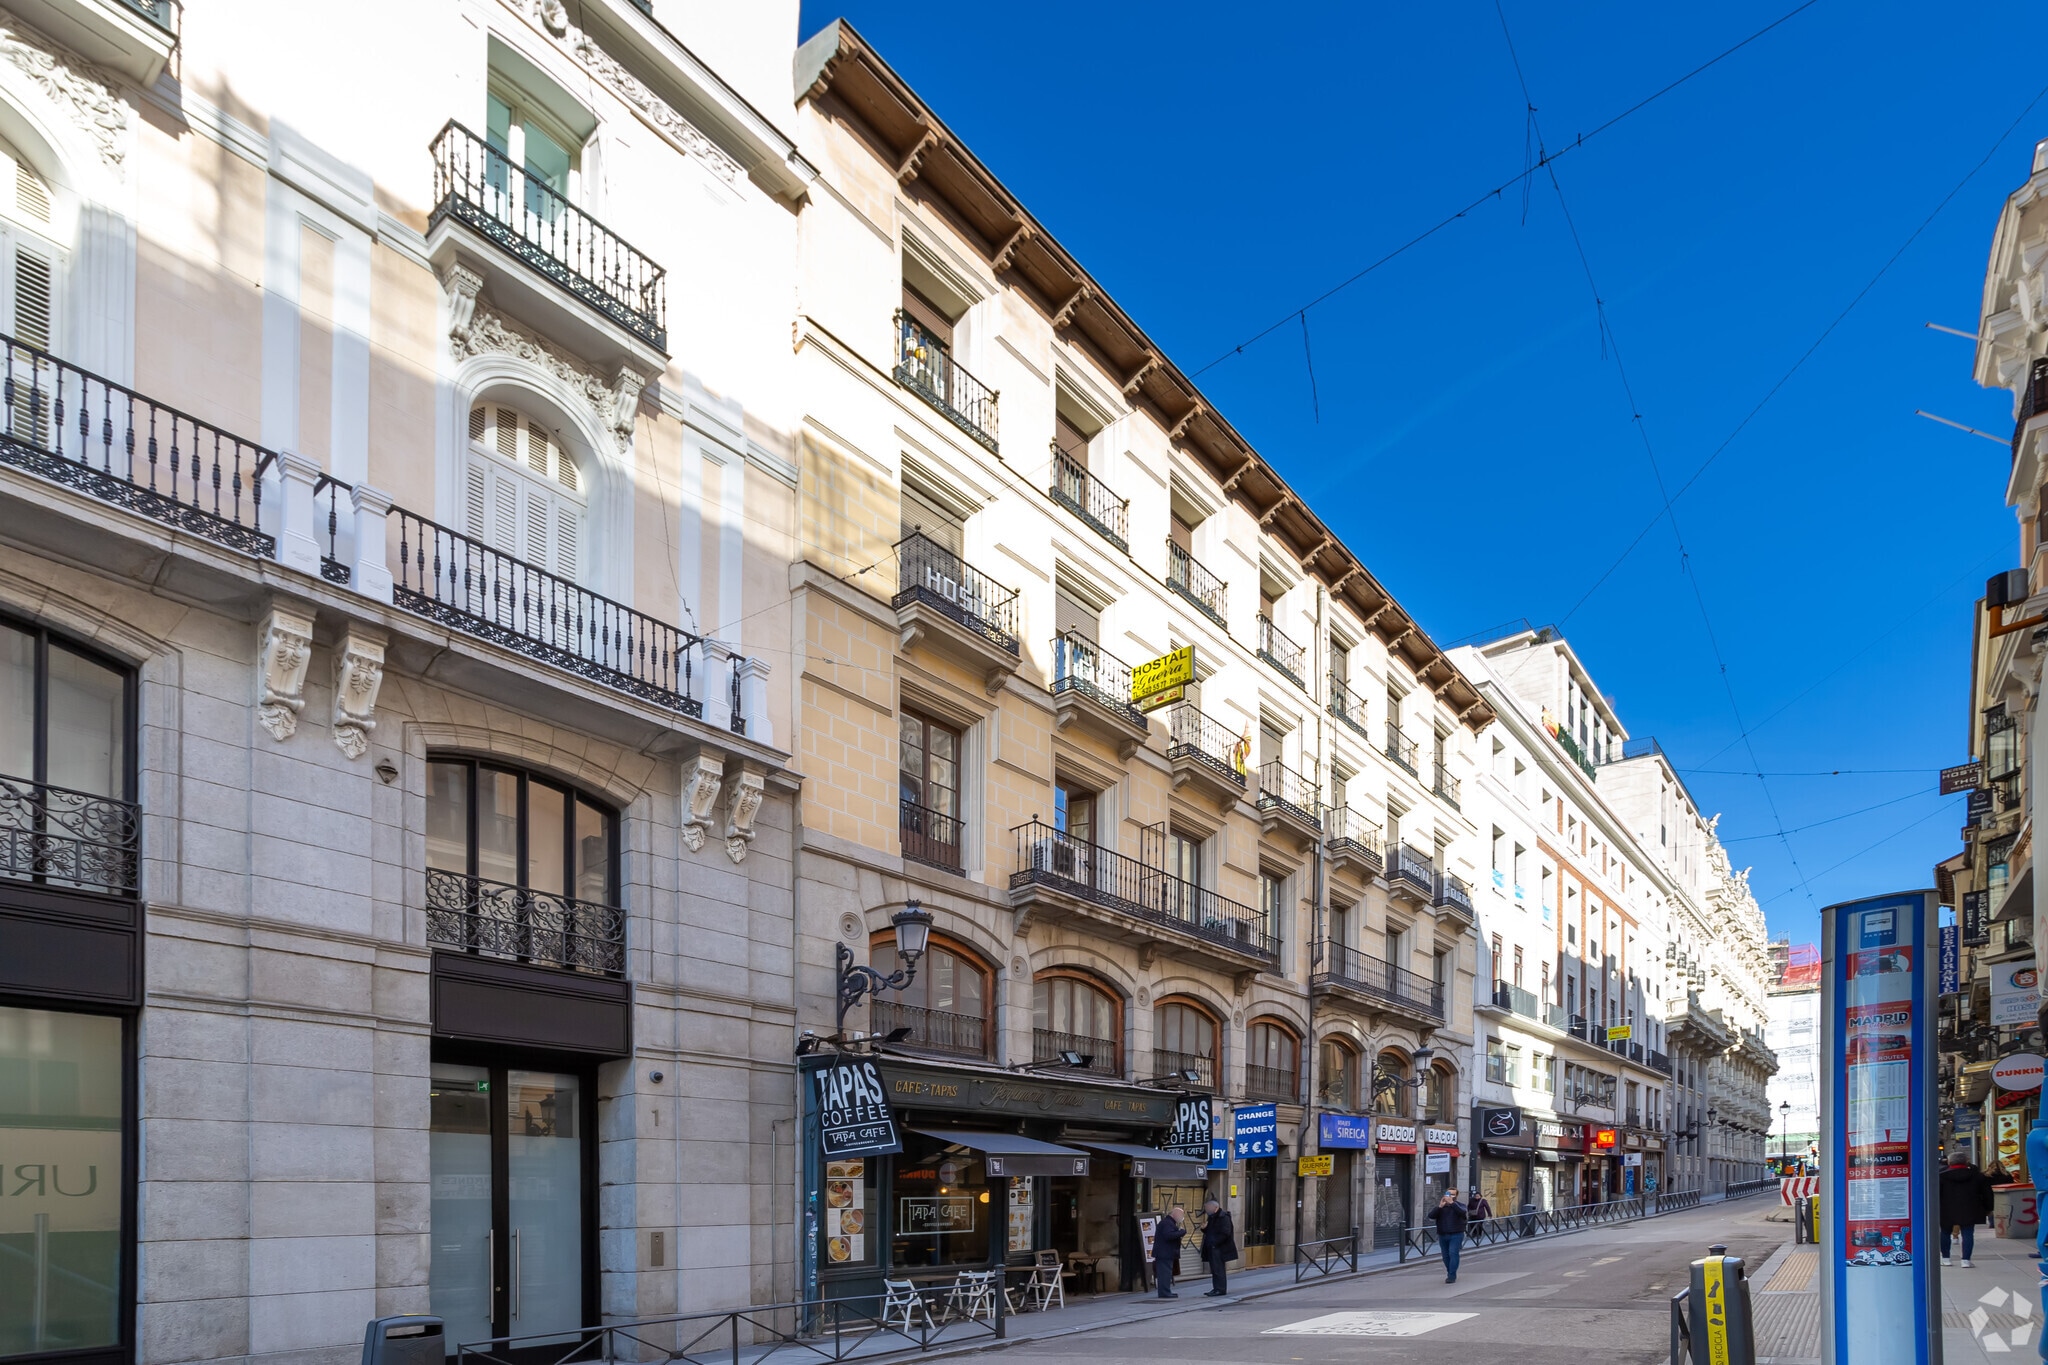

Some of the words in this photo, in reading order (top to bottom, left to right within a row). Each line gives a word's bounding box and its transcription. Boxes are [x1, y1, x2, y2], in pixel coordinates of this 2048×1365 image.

[1133, 650, 1187, 677] HOSTAL
[1137, 664, 1183, 690] Guerra
[1953, 777, 1977, 786] THC
[1849, 1012, 1909, 1028] MADRID
[1996, 1067, 2043, 1077] DUNKIN
[816, 1062, 883, 1111] TAPAS
[895, 1080, 922, 1094] CAFE
[930, 1084, 958, 1097] TAPAS
[1104, 1100, 1121, 1110] CAFE
[1128, 1101, 1147, 1112] TAPAS
[651, 1109, 659, 1126] 1
[822, 1104, 889, 1127] COFFEE
[1171, 1101, 1209, 1133] APAS
[1238, 1110, 1274, 1120] CHANGE
[829, 1131, 856, 1144] TAPA
[860, 1127, 886, 1138] CAFE
[1168, 1131, 1210, 1144] OFFEE
[1237, 1124, 1275, 1135] MONEY
[1337, 1127, 1365, 1139] SIREICA
[1382, 1127, 1414, 1140] BACOA
[1430, 1131, 1456, 1142] BACOA
[1239, 1143, 1248, 1154] ¥
[1252, 1142, 1261, 1153] €
[1264, 1140, 1274, 1153] $
[1870, 1168, 1888, 1176] 024
[1891, 1167, 1909, 1175] 758
[909, 1204, 936, 1220] TAPA
[941, 1204, 967, 1219] CAFE
[2017, 1197, 2040, 1225] 3
[1714, 1329, 1724, 1359] RECICLA
